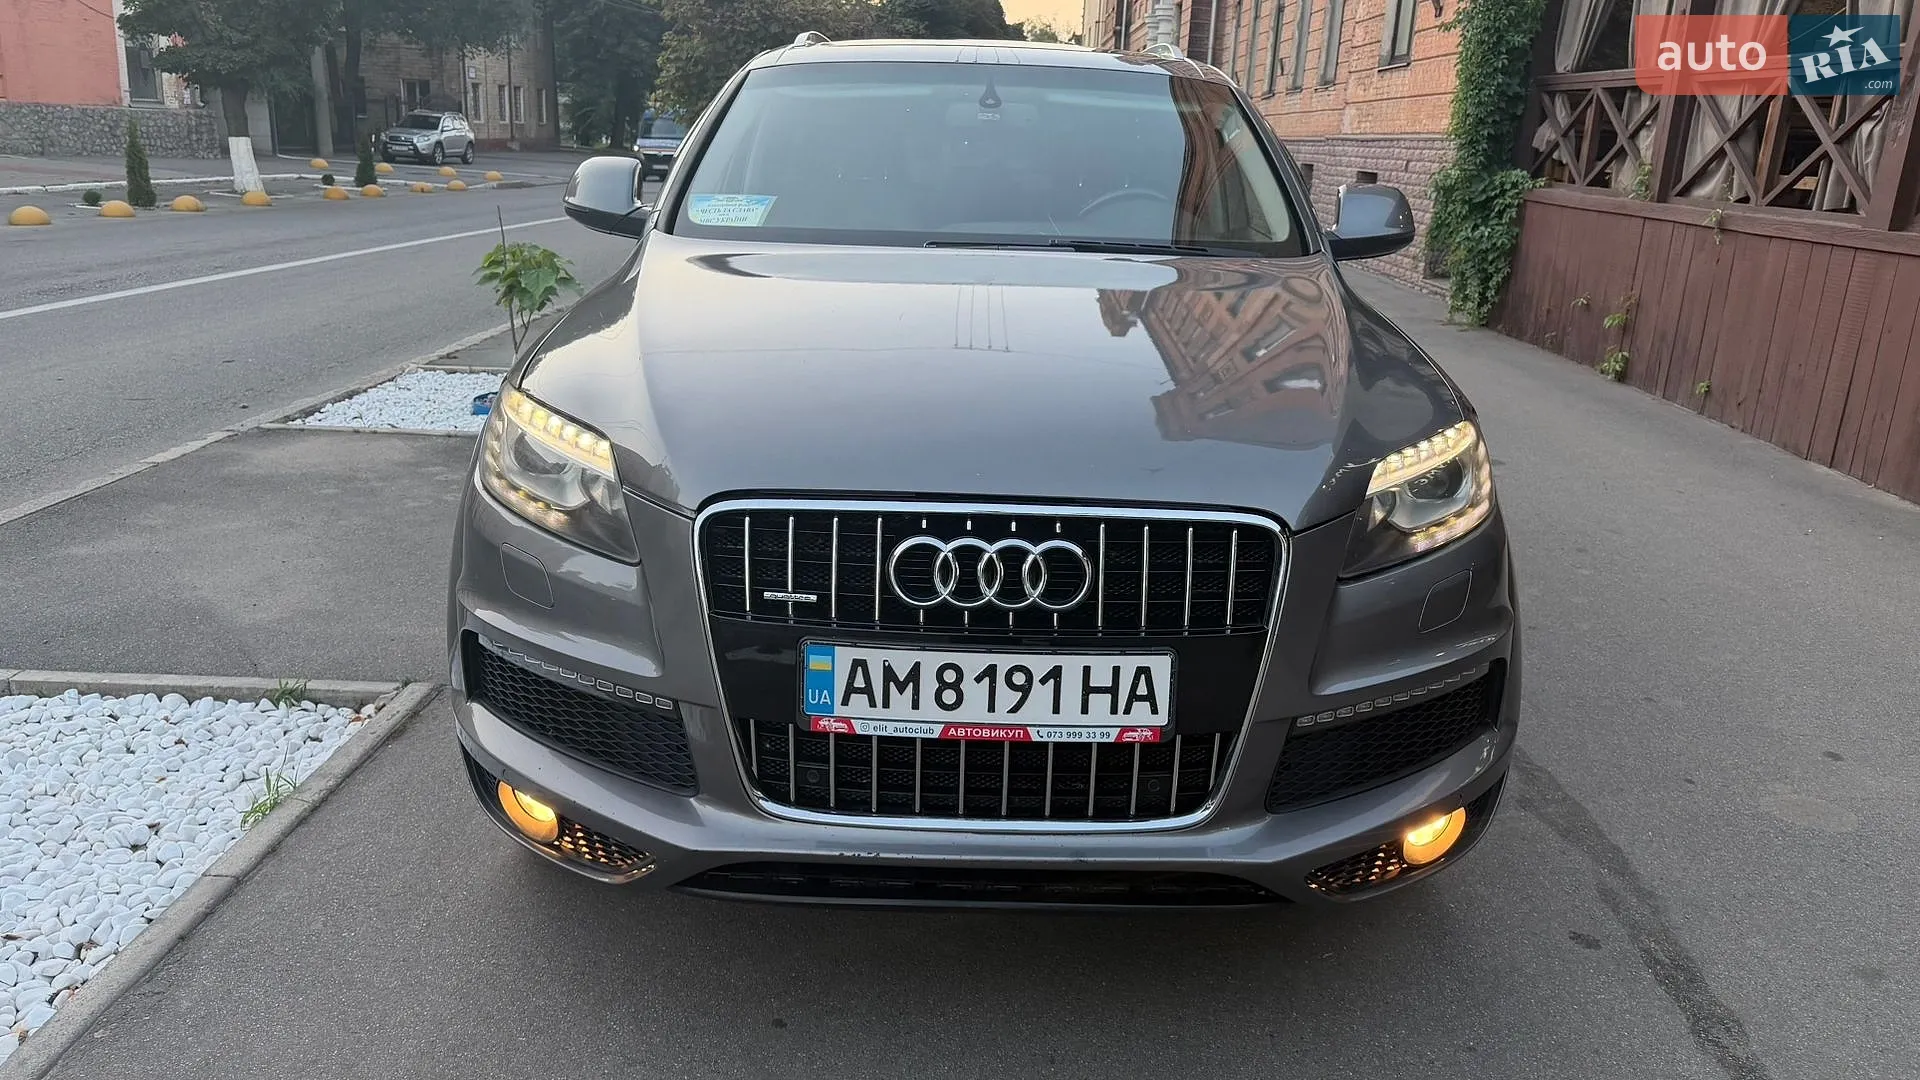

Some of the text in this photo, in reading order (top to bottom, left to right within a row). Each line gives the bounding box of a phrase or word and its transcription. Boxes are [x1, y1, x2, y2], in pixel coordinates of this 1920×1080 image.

[840, 658, 1160, 716] AM 8191 HA
[808, 689, 831, 705] UA
[873, 724, 935, 735] elit_autoclub
[947, 727, 1024, 738] АВТОВИКУП
[1046, 731, 1111, 740] 073 999 33 99
